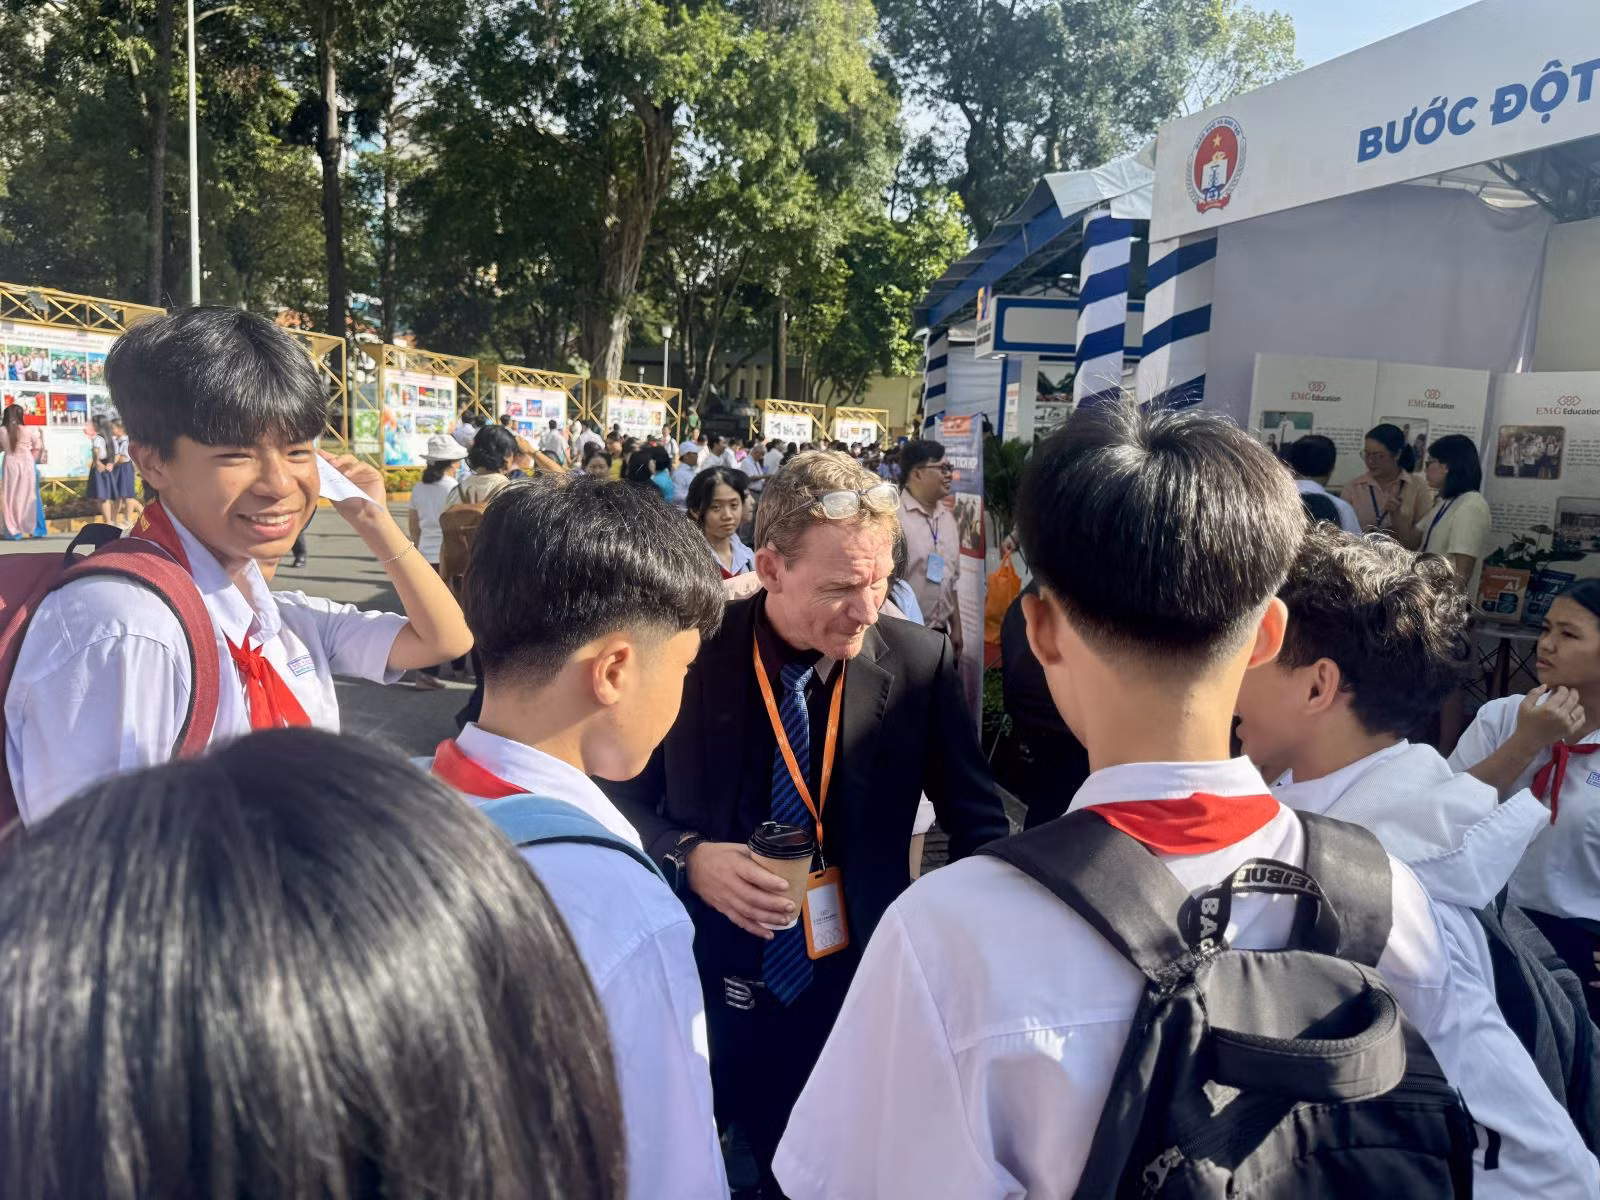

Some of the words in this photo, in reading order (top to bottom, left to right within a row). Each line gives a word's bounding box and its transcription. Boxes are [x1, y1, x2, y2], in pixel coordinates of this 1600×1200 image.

[1357, 96, 1478, 163] BƯỚC
[1490, 58, 1600, 126] ĐỘT
[1291, 392, 1311, 401] EMG
[1408, 399, 1426, 408] EMG
[1427, 401, 1455, 410] Education
[1536, 407, 1561, 415] EMG
